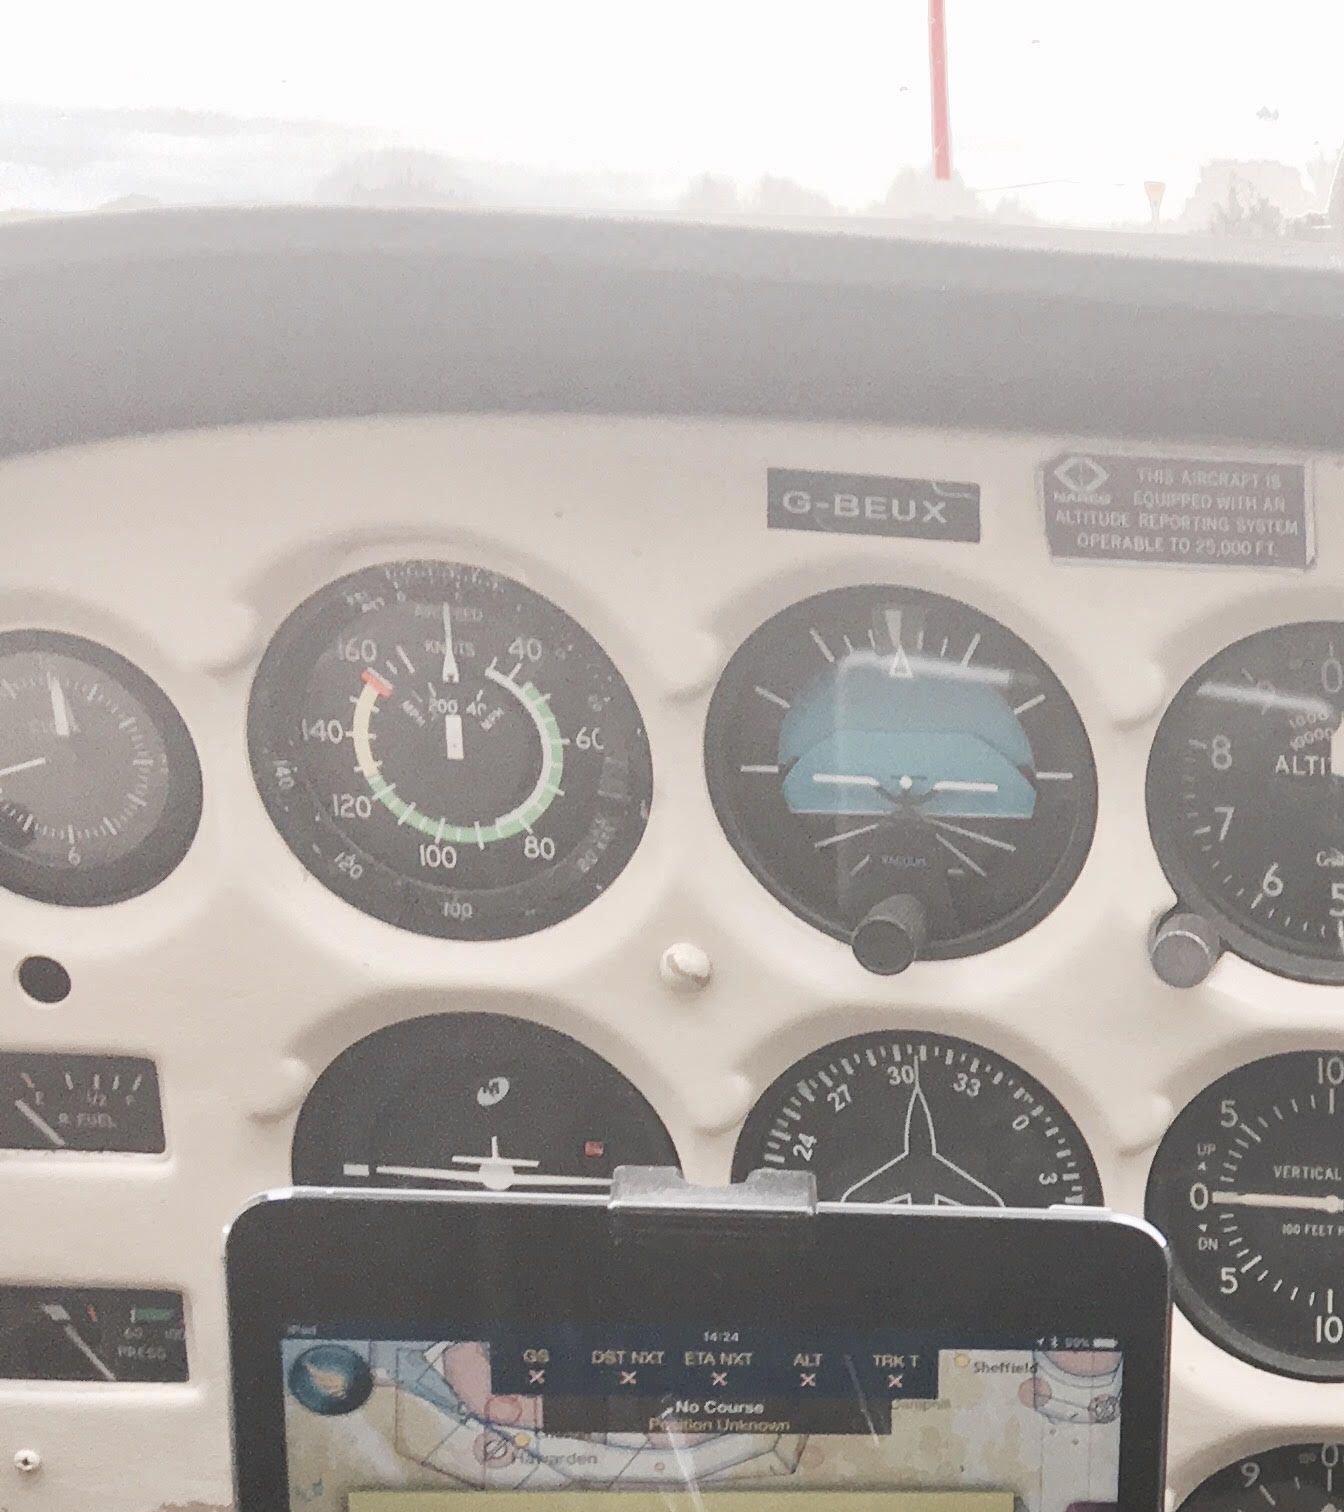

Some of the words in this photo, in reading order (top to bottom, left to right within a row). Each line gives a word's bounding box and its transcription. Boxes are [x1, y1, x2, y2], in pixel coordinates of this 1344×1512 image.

[782, 490, 947, 524] G-BEUX
[1056, 511, 1128, 528] ALTITUDE
[1140, 513, 1229, 531] REPORTING
[1237, 519, 1297, 535] SYSTEM
[1077, 533, 1163, 552] OPERABLE
[338, 638, 378, 662] 160
[509, 638, 543, 662] 40
[1321, 659, 1343, 693] 0
[302, 721, 342, 744] 140
[1211, 735, 1233, 770] 8
[333, 797, 372, 820] 120
[1214, 807, 1235, 841] 7
[419, 844, 458, 869] 100
[523, 838, 556, 861] 80
[1262, 862, 1283, 897] 6
[1318, 1057, 1344, 1085] 10
[1221, 1100, 1238, 1127] 5
[1274, 1165, 1341, 1181] VERTICAL
[1282, 1223, 1301, 1235] 100
[1304, 1224, 1335, 1236] FEET
[1316, 1316, 1343, 1343] 10
[793, 1352, 823, 1368] ALT
[675, 1400, 699, 1414] No
[706, 1400, 764, 1416] Course
